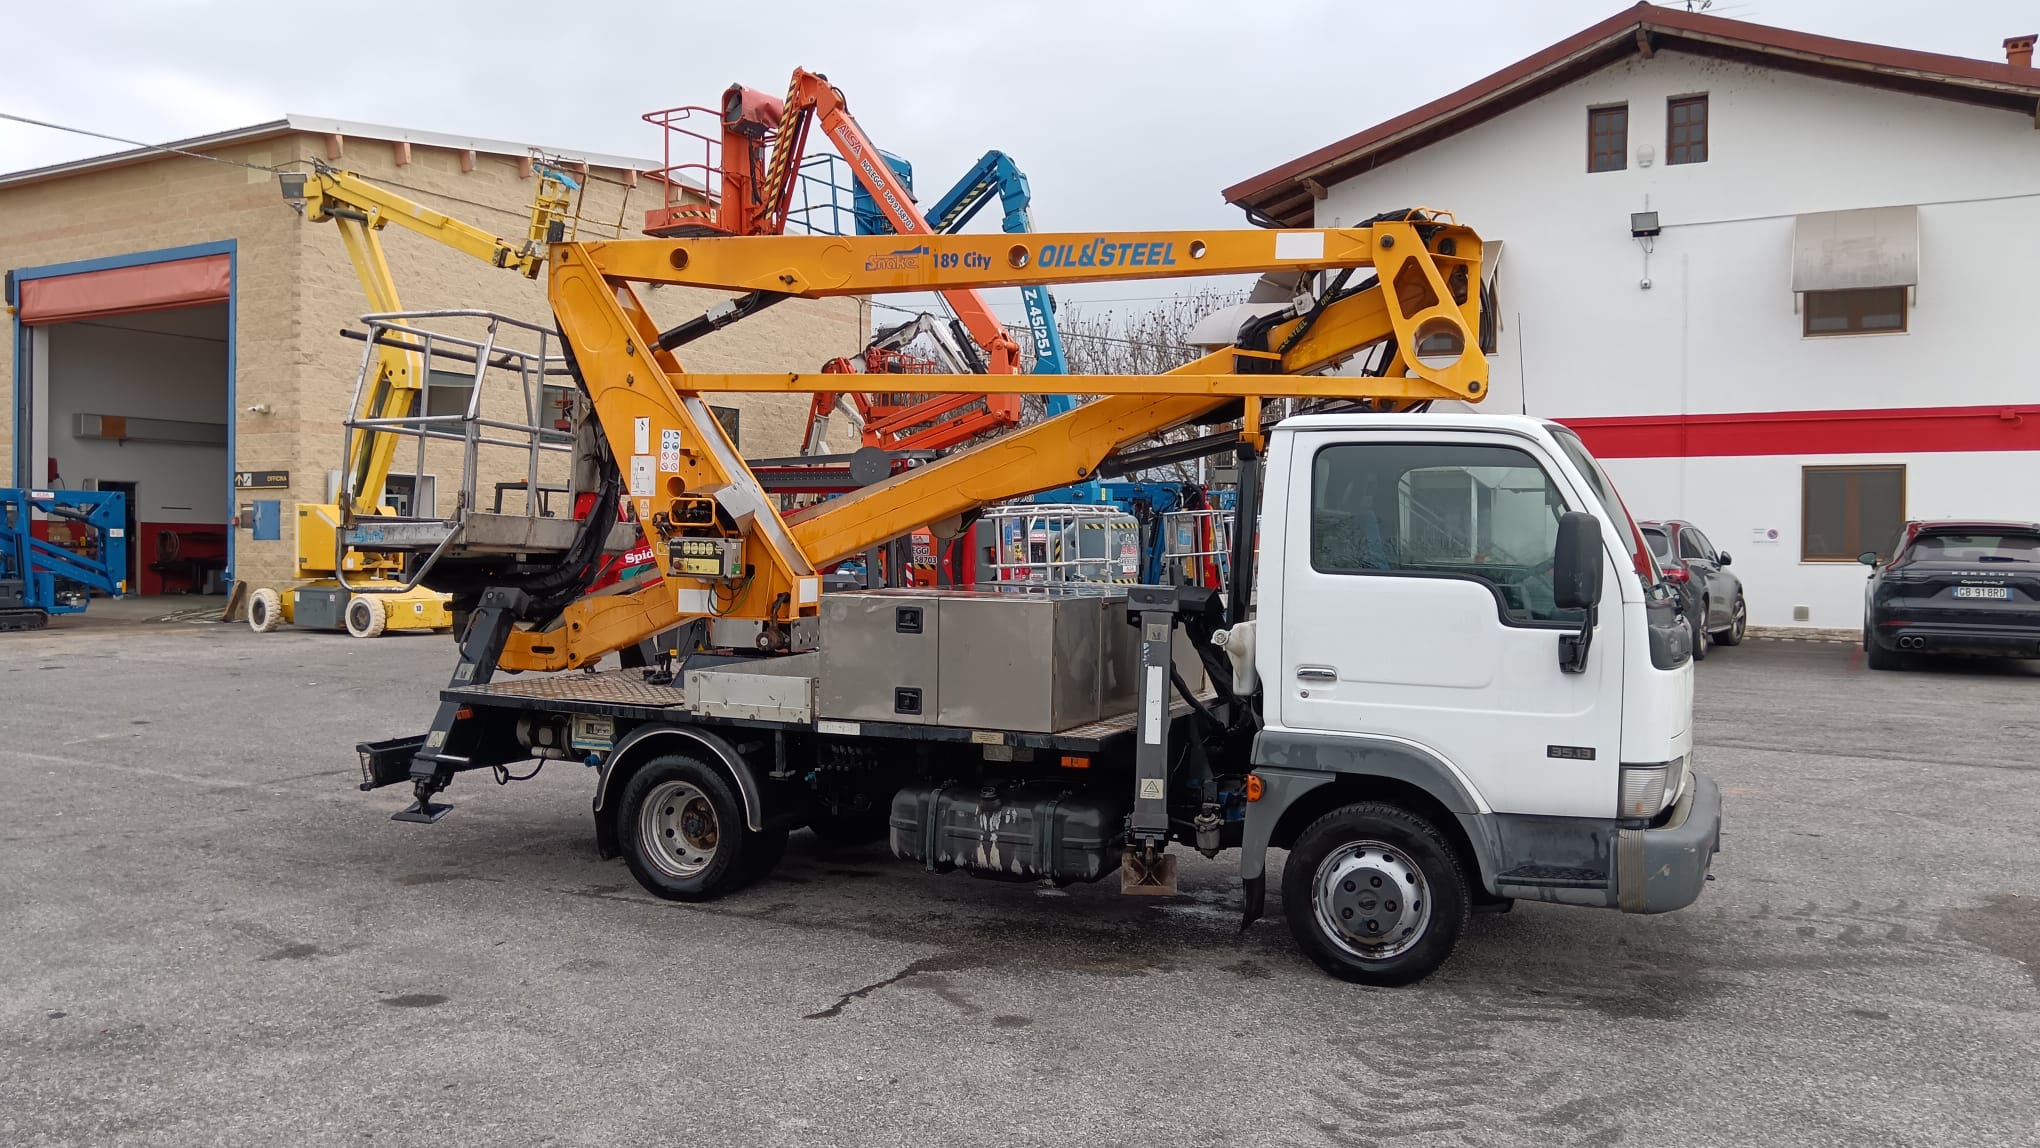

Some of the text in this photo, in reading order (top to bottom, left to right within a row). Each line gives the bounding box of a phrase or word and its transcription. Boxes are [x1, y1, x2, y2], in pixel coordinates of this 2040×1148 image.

[838, 124, 862, 155] ALSA
[861, 160, 884, 189] NOLEGGI
[933, 253, 959, 268] 189
[963, 252, 992, 270] City
[624, 549, 654, 564] Spid
[914, 556, 937, 564] 58703
